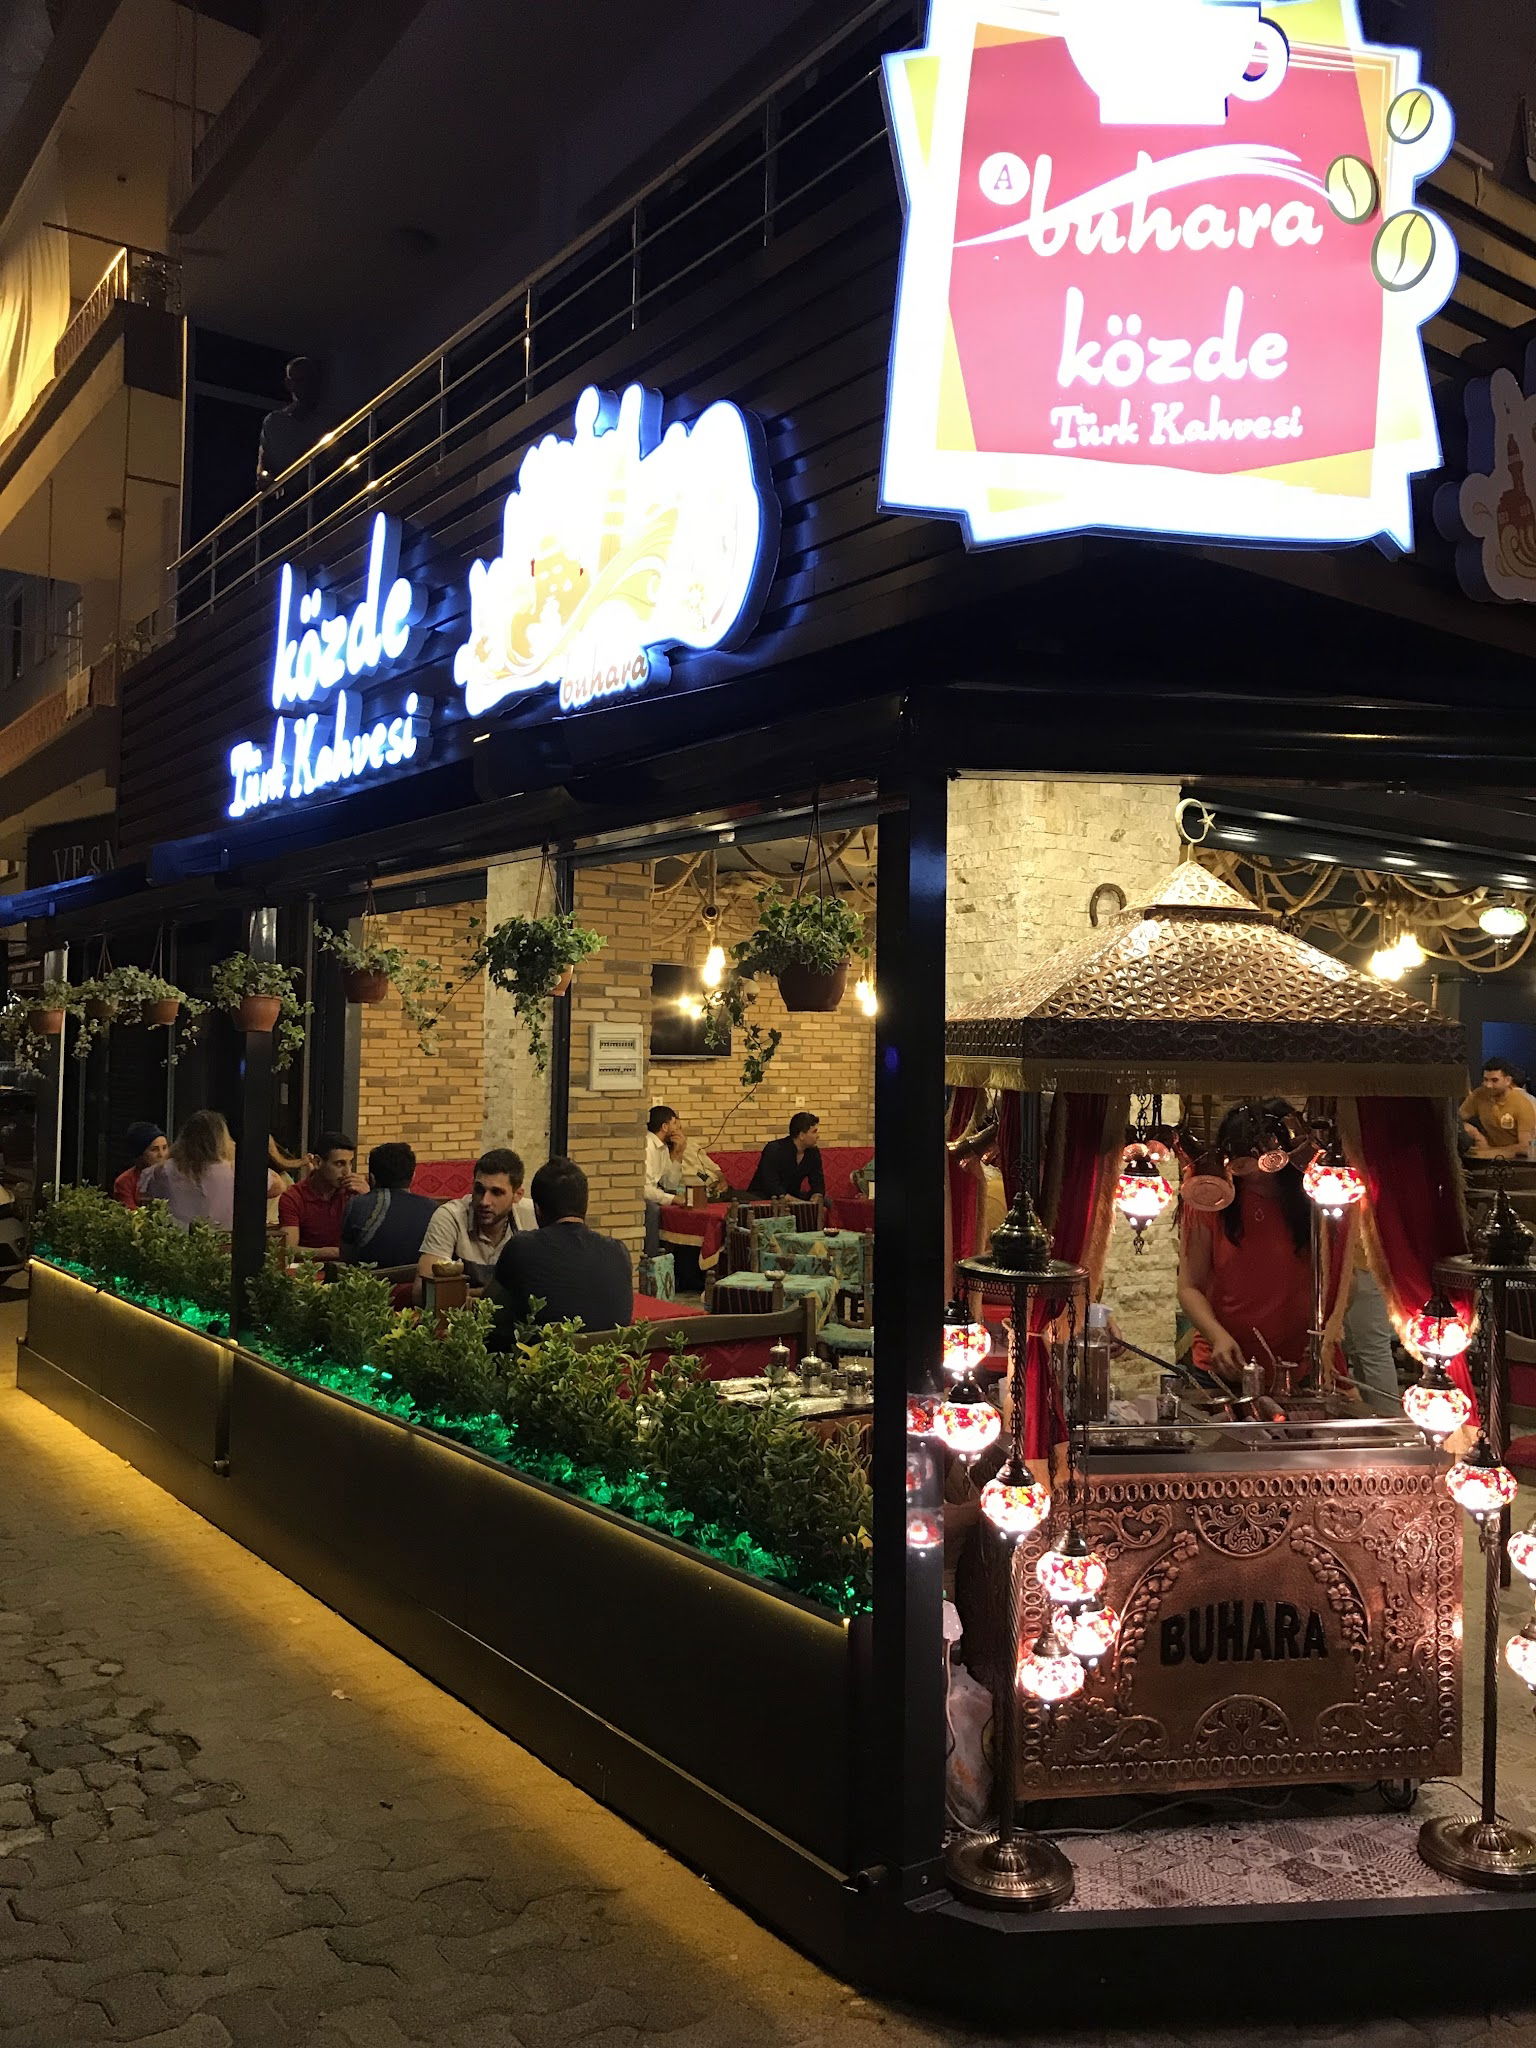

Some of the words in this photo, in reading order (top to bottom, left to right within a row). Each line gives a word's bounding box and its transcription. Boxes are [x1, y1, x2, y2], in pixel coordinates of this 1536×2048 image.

[993, 163, 1014, 190] A
[1029, 151, 1323, 257] buhara
[1058, 285, 1288, 387] közde
[1051, 399, 1139, 449] Türk
[1149, 395, 1303, 445] Kahvesi
[272, 511, 414, 710] közde
[562, 652, 648, 705] buhara
[228, 716, 287, 818] Türk
[290, 690, 419, 798] Kahvesi
[1160, 1600, 1326, 1665] BUHARA
